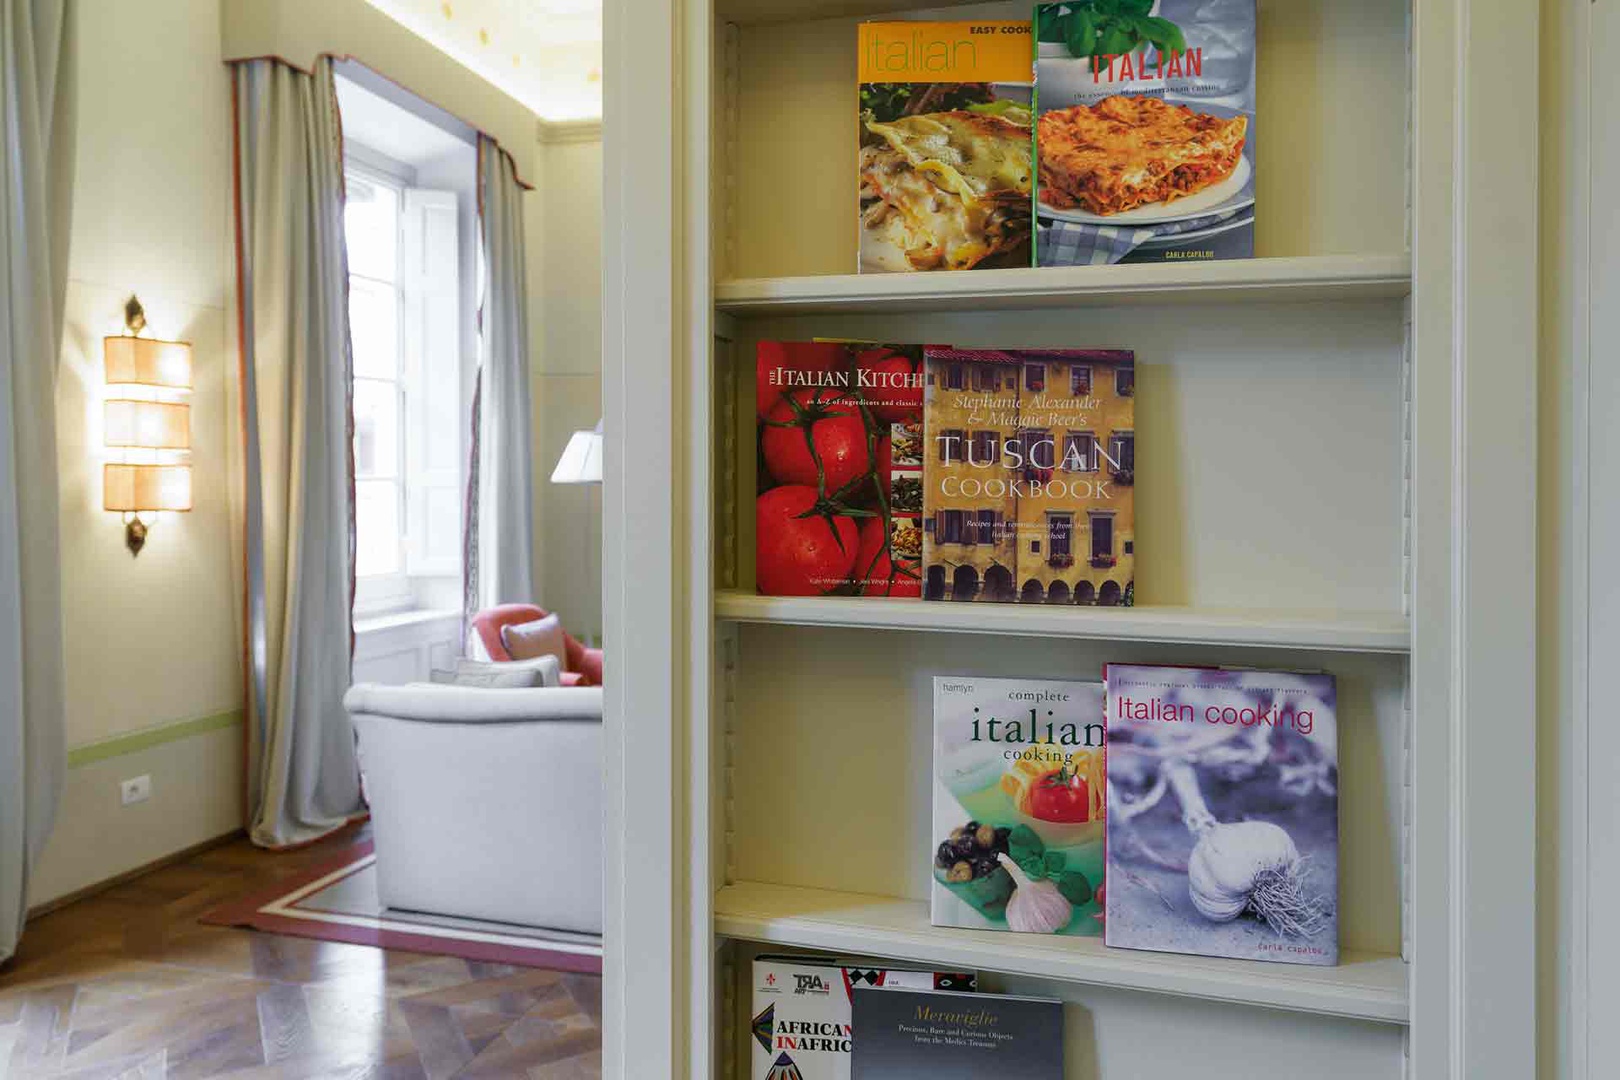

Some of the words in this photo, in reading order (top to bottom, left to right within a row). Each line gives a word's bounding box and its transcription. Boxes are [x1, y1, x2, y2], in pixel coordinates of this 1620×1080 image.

[970, 26, 997, 35] EASY
[1001, 26, 1033, 35] COOK
[1093, 47, 1203, 84] ITALIAN
[776, 366, 849, 387] ITALIAN
[841, 399, 879, 407] ingredients
[952, 394, 1022, 412] Stephanie
[1028, 394, 1102, 410] Alexander
[968, 412, 983, 425] &
[987, 411, 1042, 428] Maggie
[1048, 412, 1088, 426] Beer's
[935, 435, 1125, 471] TUSCAN
[941, 475, 1112, 499] COOKBOOK
[966, 519, 991, 529] Recipes
[943, 682, 974, 695] hamlyn
[1008, 688, 1071, 703] complete
[1118, 696, 1194, 723] Italian
[1205, 702, 1315, 735] cooking
[971, 707, 1104, 747] italian
[1003, 747, 1074, 767] cooking
[913, 1004, 999, 1026] Meraviglie
[777, 1020, 852, 1037] AFRICAN
